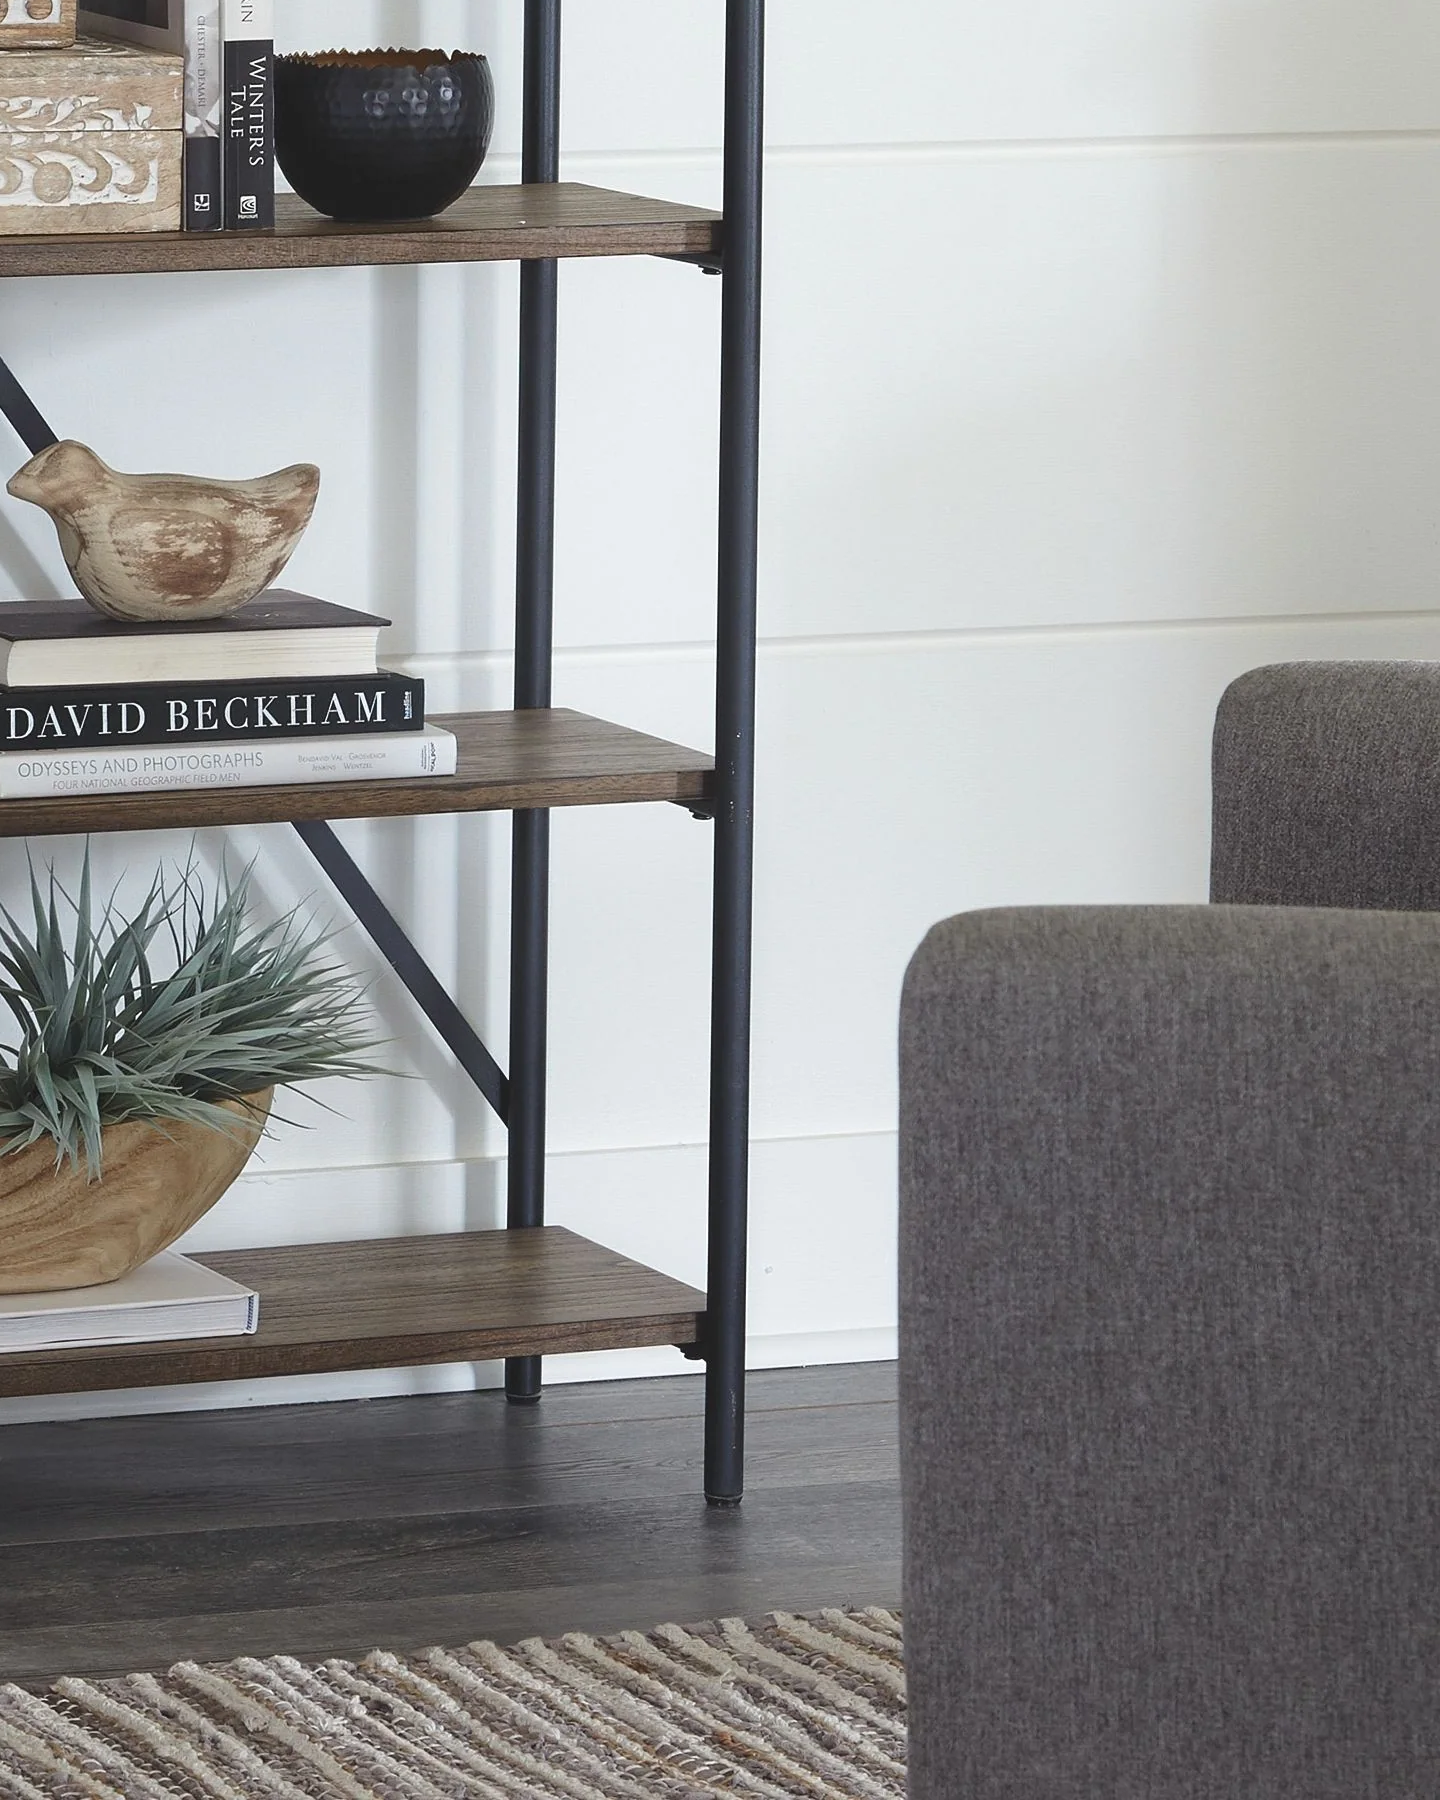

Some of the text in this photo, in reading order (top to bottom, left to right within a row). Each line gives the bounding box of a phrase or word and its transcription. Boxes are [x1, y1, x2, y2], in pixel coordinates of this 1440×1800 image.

[197, 15, 205, 59] CHESTER
[231, 85, 247, 138] TALE
[249, 56, 267, 166] WINTER'S
[6, 691, 386, 740] DAVID BECKHAM
[18, 752, 264, 778] ODYSSEYS AND PHOTOGRAPHS
[53, 773, 240, 790] FOUR NATIONAL GEOGRAPHIC FIELD MEN
